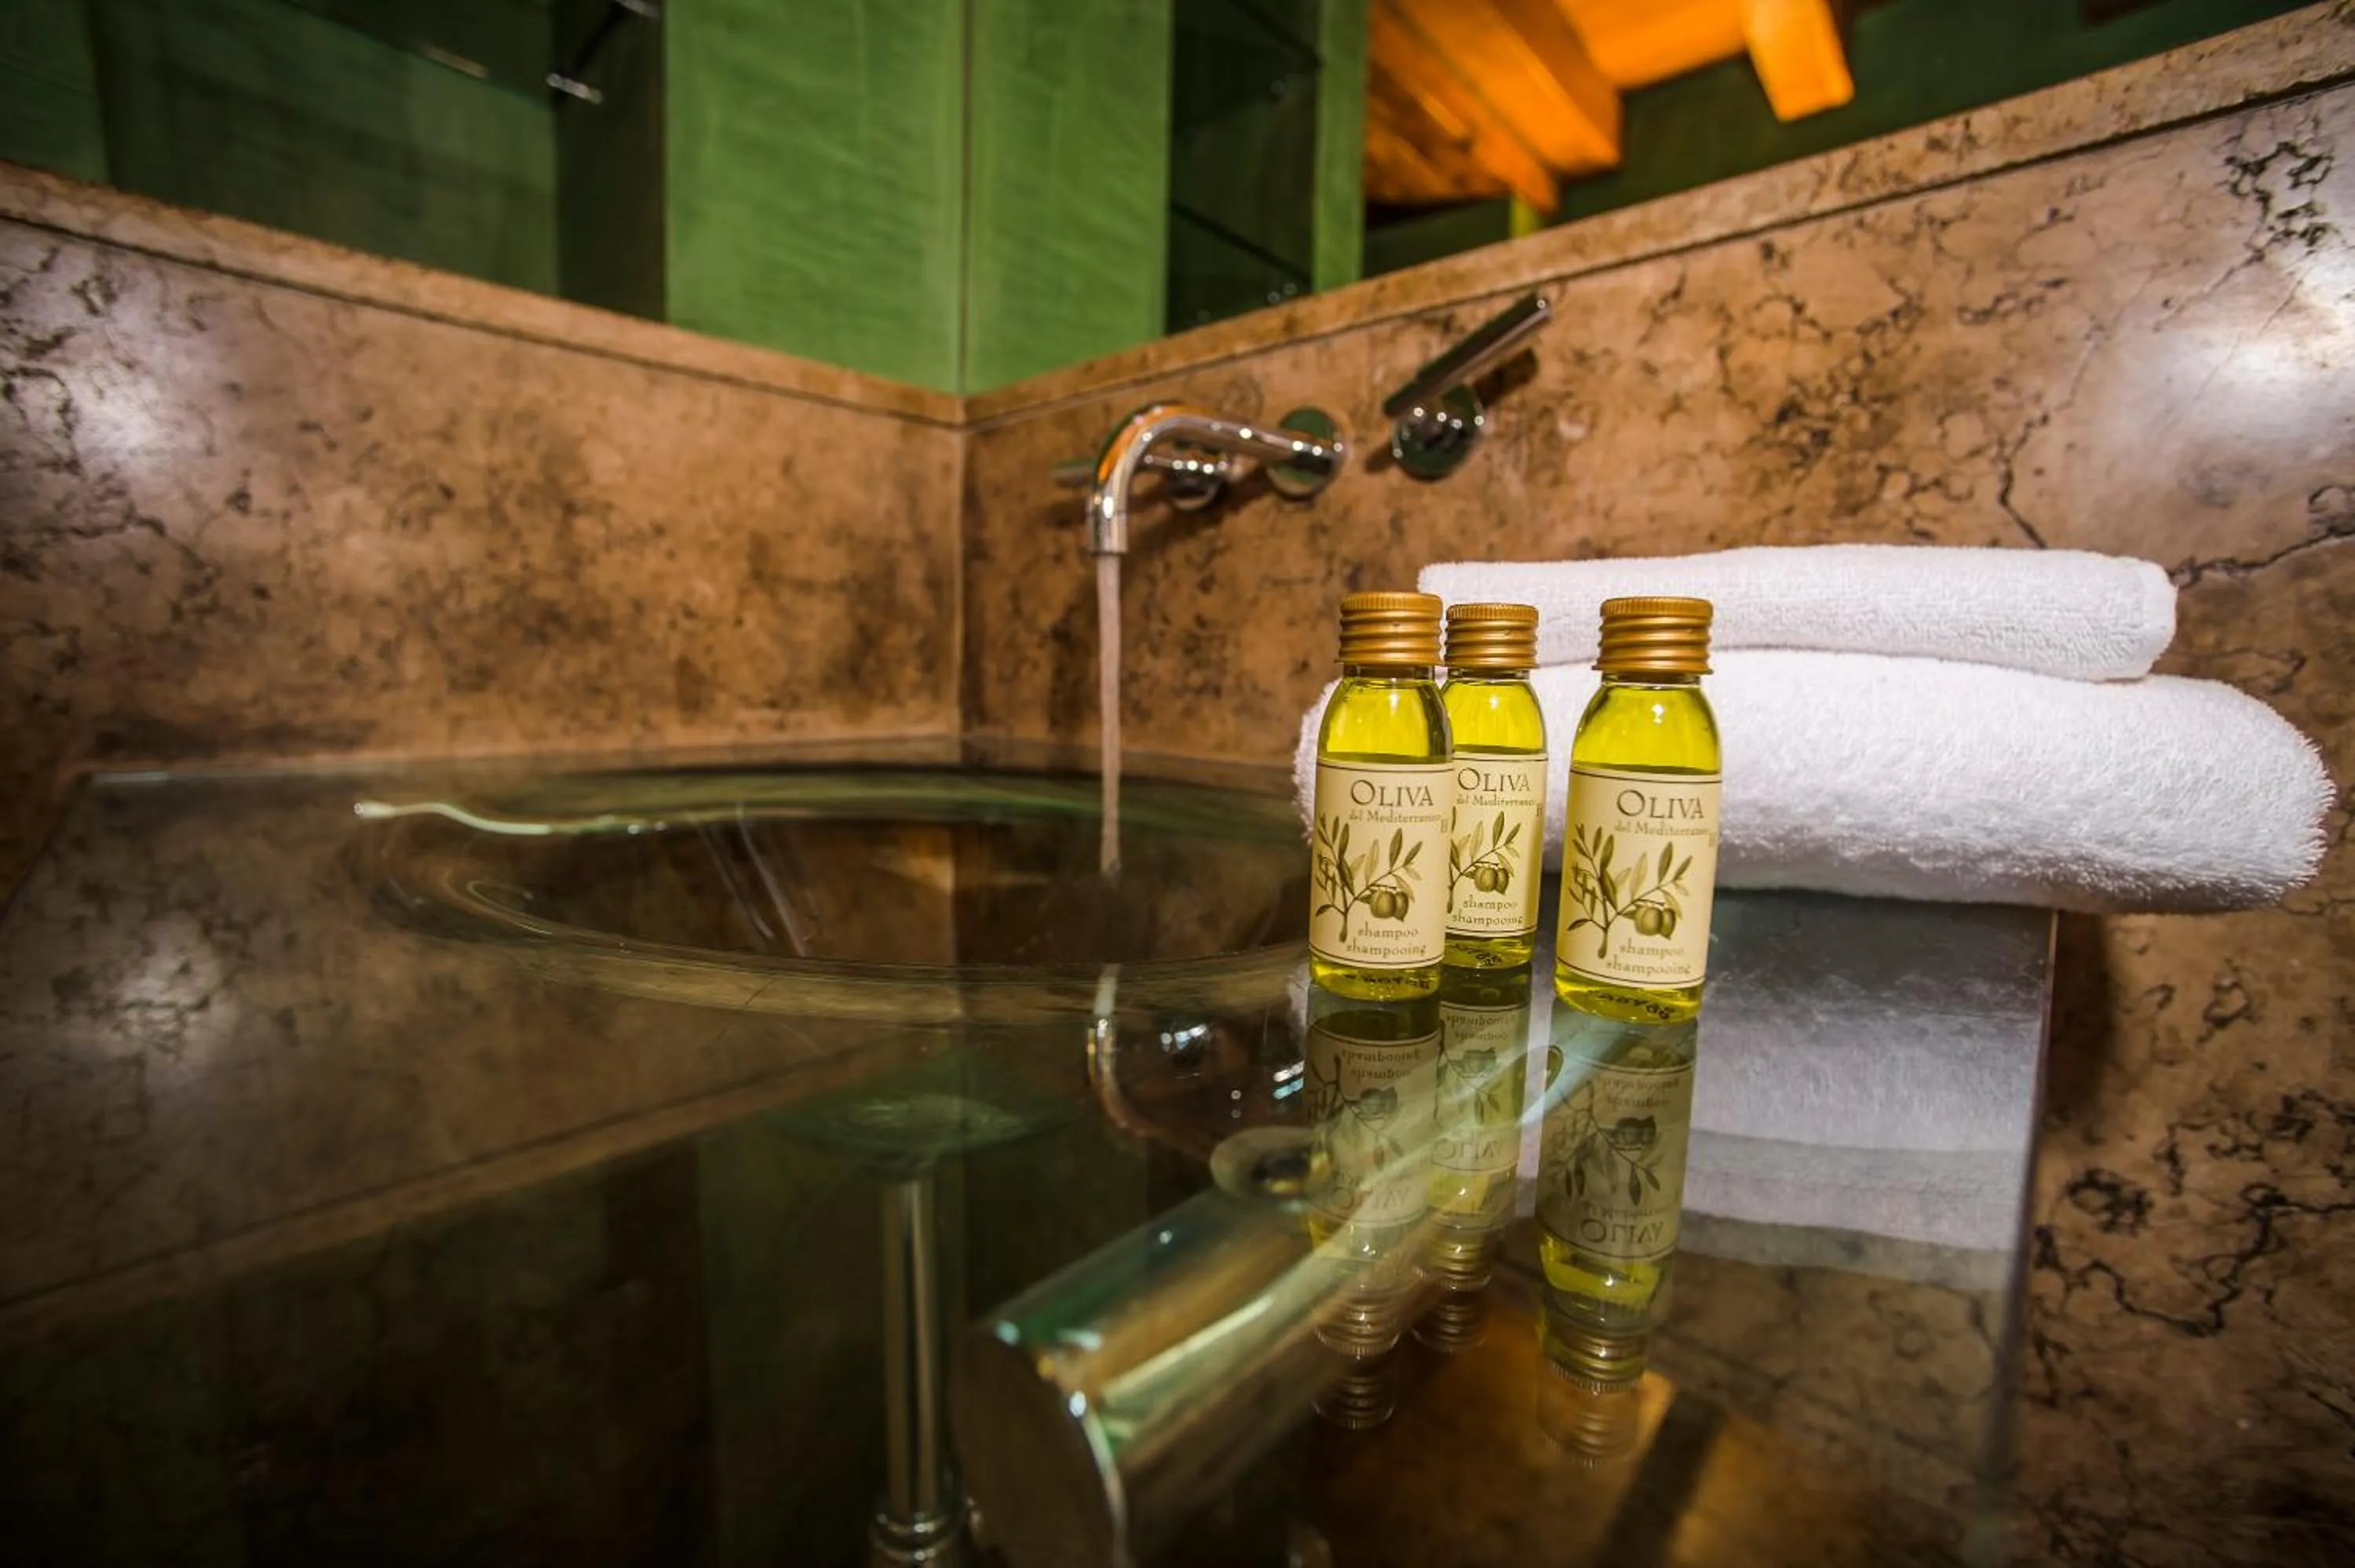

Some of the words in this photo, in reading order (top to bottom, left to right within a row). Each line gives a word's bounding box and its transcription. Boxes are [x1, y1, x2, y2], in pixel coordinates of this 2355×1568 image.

[1457, 767, 1531, 792] OLIVA
[1350, 779, 1434, 807] OLIVA
[1616, 789, 1704, 819] OLIVA
[1462, 894, 1517, 912] shampoo
[1357, 921, 1418, 940] shampoo
[1345, 937, 1427, 958] shampooing
[1619, 937, 1685, 960] shampoo
[1605, 954, 1692, 976] shampooing
